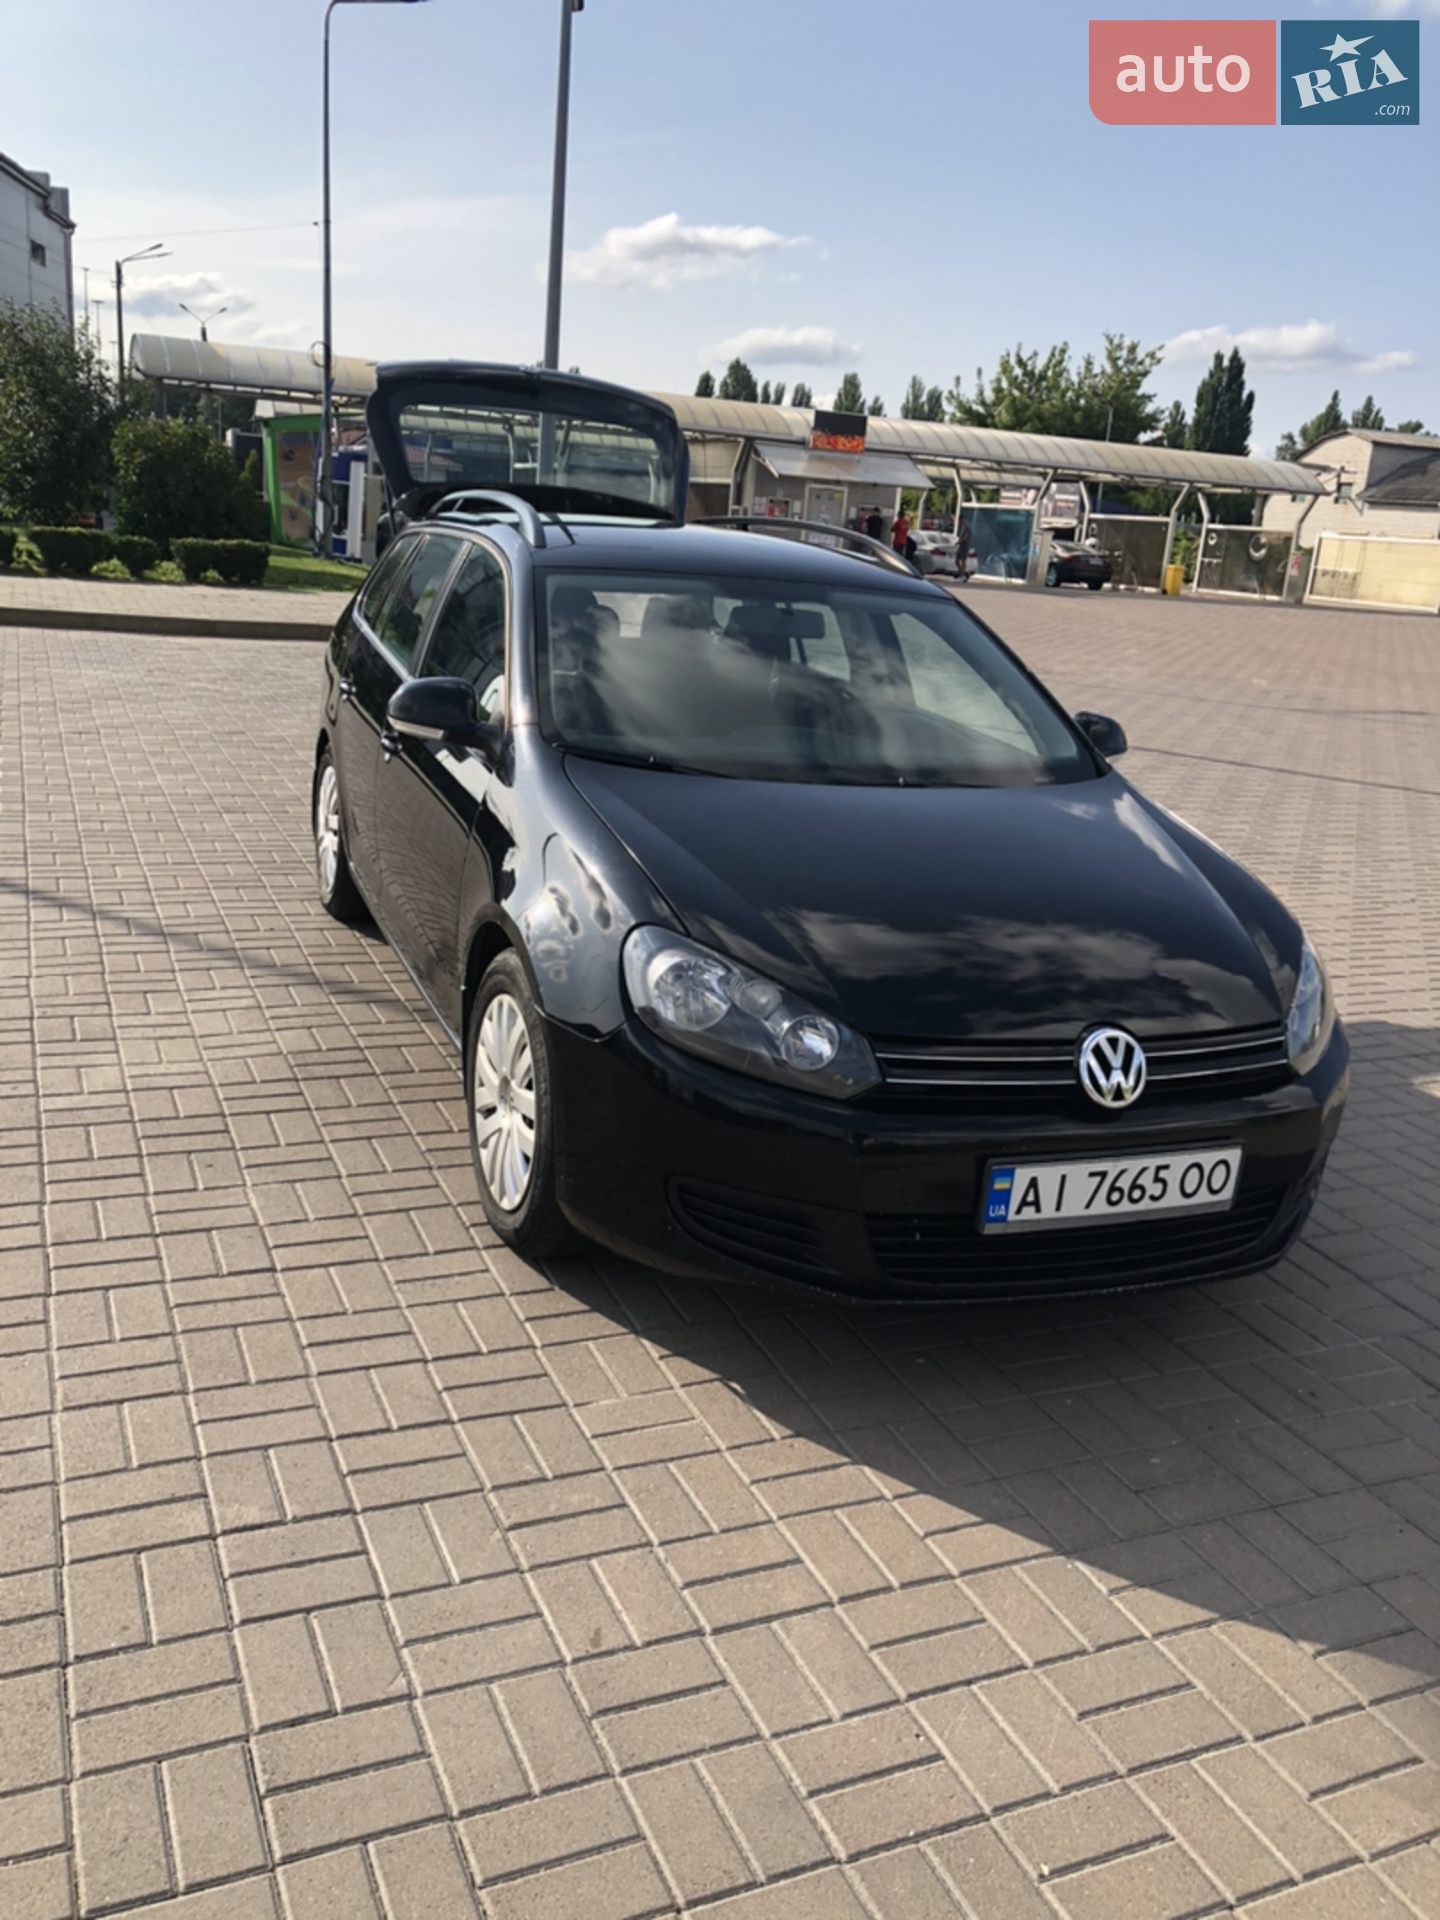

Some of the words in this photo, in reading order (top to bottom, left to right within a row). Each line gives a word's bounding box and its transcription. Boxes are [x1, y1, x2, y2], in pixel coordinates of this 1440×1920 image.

[1015, 1174, 1067, 1215] AI
[1084, 1164, 1170, 1210] 7665
[988, 1204, 1007, 1218] UA
